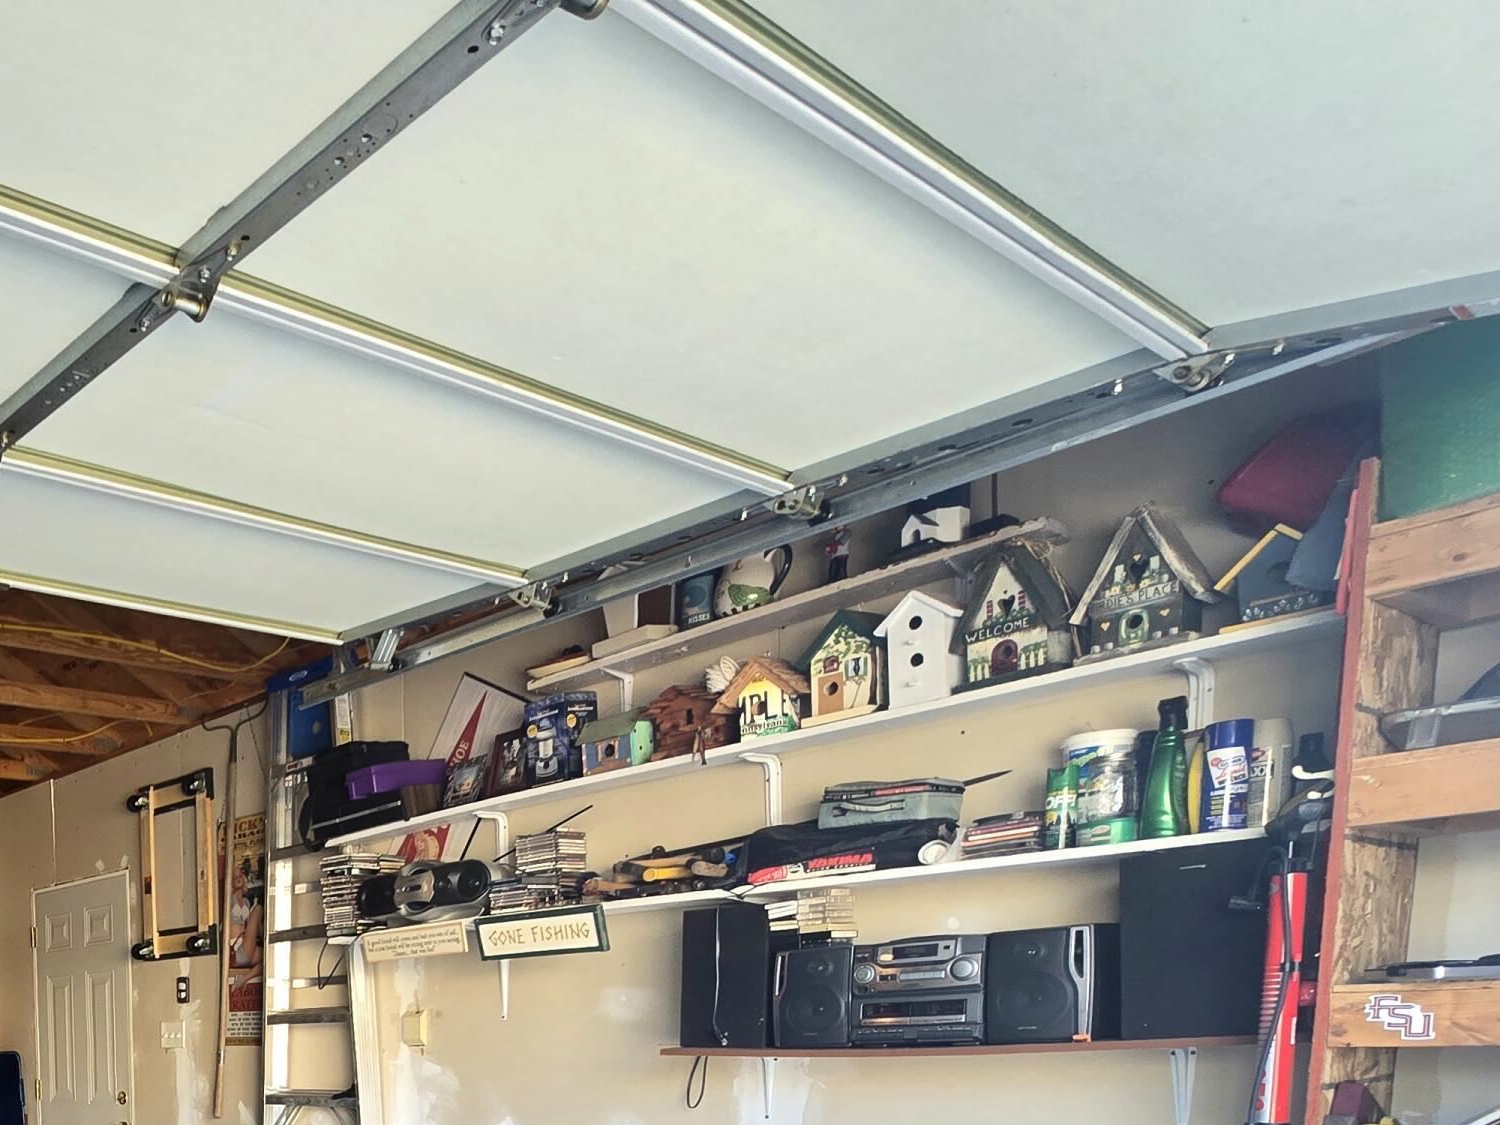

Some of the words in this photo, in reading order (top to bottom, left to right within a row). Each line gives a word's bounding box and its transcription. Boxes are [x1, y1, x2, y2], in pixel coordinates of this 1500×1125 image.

[1138, 582, 1178, 601] PLACE
[965, 617, 1029, 643] WELCOME
[1045, 793, 1077, 810] OFF!
[807, 852, 873, 869] YAKIMA
[488, 928, 525, 947] GONE
[530, 922, 590, 943] FISHING
[1368, 995, 1433, 1039] FSU
